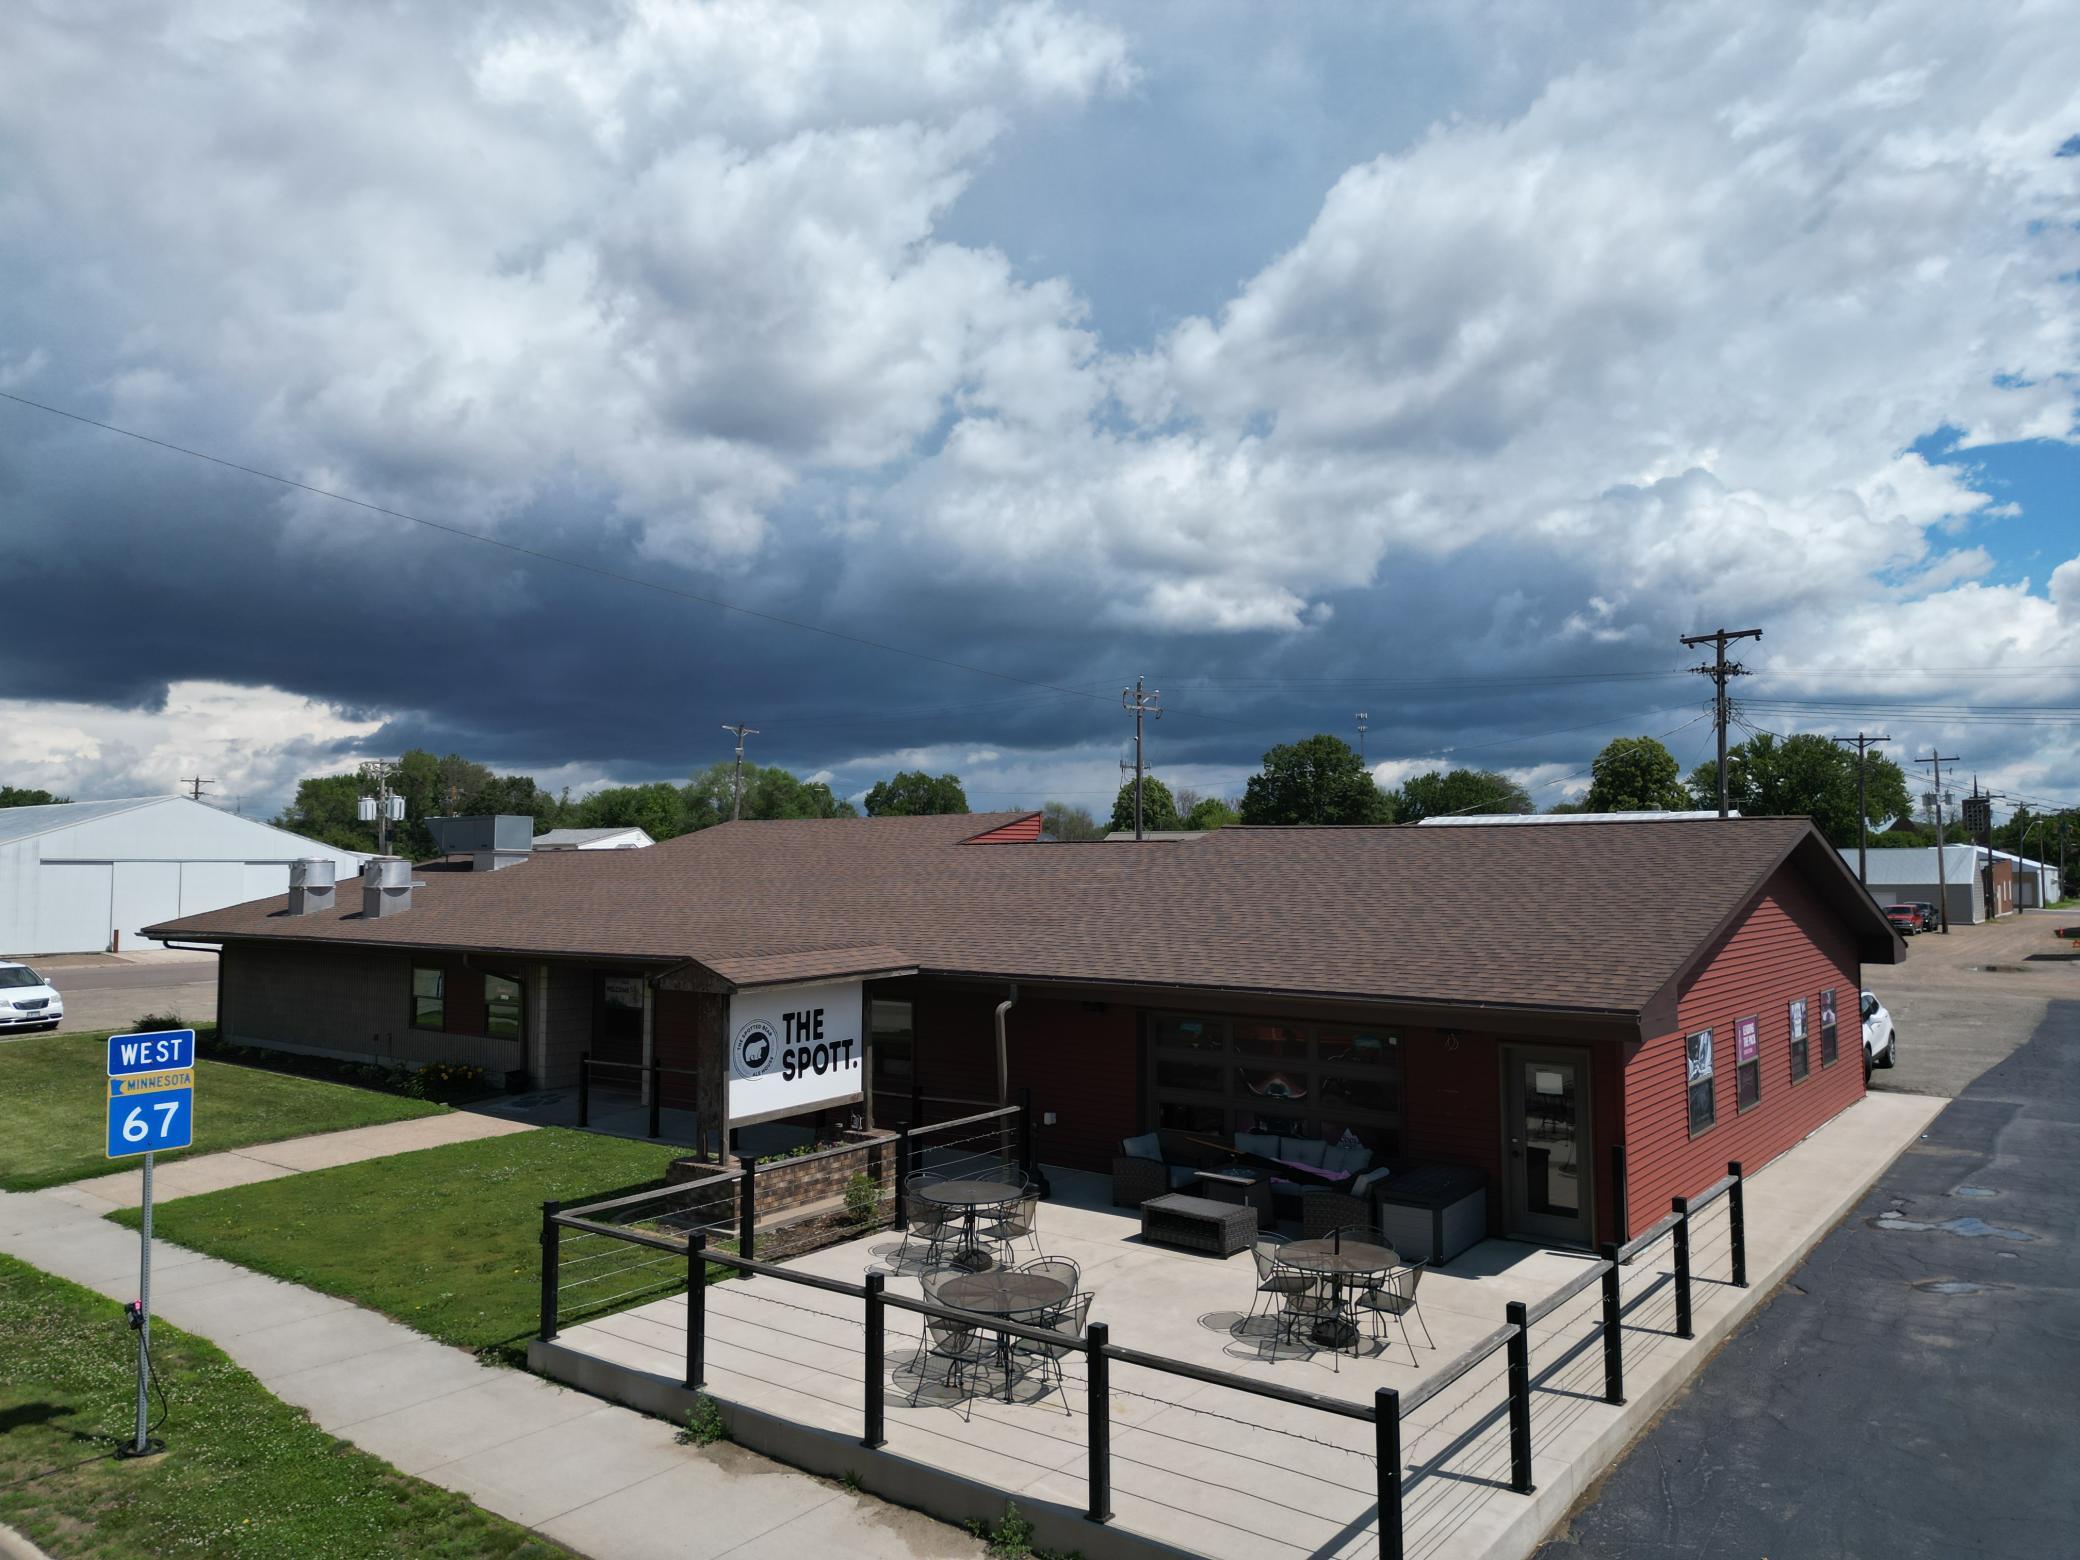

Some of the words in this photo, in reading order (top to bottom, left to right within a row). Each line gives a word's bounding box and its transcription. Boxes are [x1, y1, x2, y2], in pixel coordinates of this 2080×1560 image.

[742, 1024, 762, 1039] SPOTTED
[762, 1025, 773, 1036] BEAR
[782, 1008, 824, 1045] THE
[120, 1039, 182, 1066] WEST
[782, 1038, 858, 1082] SPOTT.
[127, 1073, 191, 1091] MINNESOTA
[122, 1101, 179, 1142] 67
